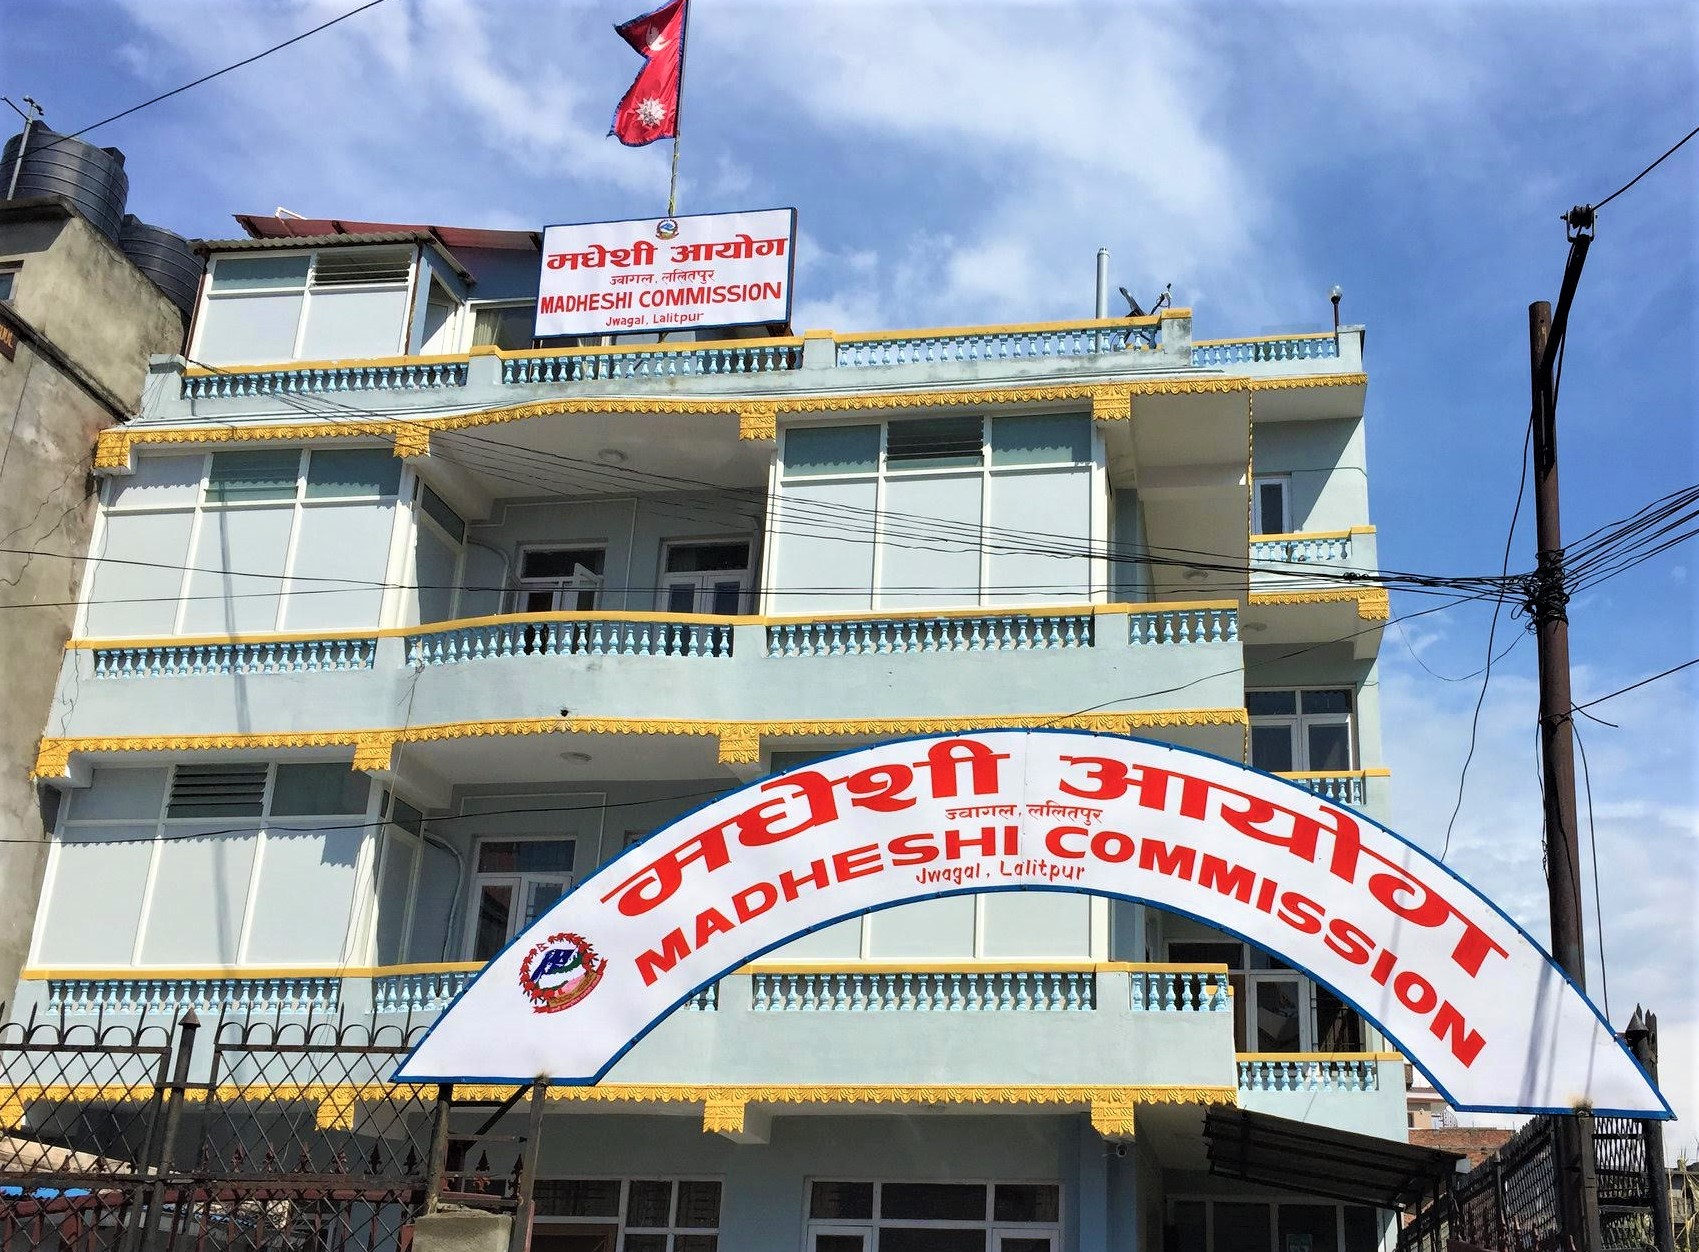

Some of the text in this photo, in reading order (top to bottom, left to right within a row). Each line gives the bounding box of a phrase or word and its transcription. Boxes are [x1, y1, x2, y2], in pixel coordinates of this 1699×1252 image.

[546, 234, 789, 271] मधेशी आयोग
[661, 269, 716, 285] ललितपुर
[540, 282, 782, 314] MADHESHI COMMISSION
[652, 312, 704, 325] Lalitpur
[1026, 800, 1104, 825] ललितपुर
[600, 739, 1509, 978] मधेशी आयोग
[1000, 858, 1085, 882] Lalitpur
[635, 826, 1486, 1068] MADHESHI COMMISSION
